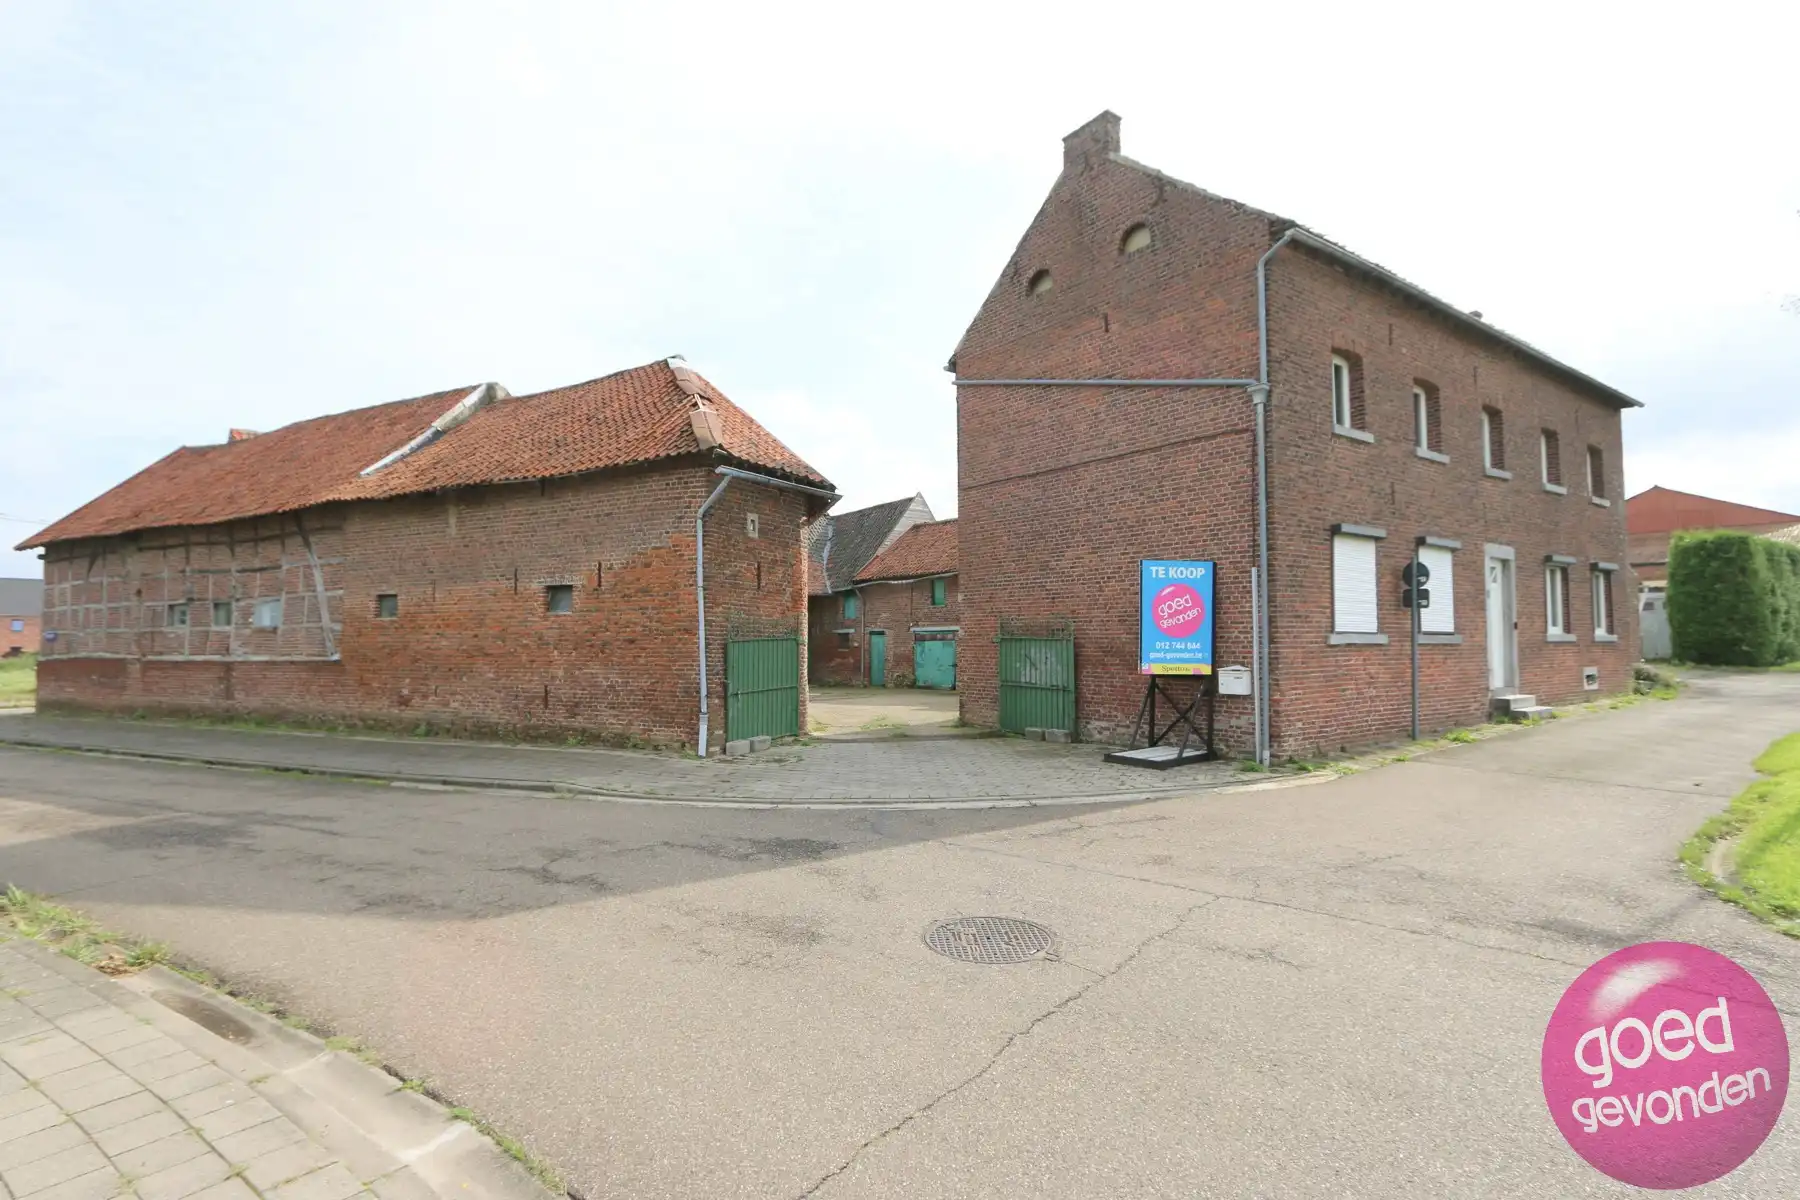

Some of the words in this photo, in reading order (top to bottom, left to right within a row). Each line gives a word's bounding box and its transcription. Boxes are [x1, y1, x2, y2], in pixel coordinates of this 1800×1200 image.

[1150, 566, 1166, 578] TE
[1169, 567, 1205, 579] KOOP
[1158, 594, 1192, 618] goed
[1160, 608, 1201, 628] gevonden
[1155, 641, 1169, 649] 012
